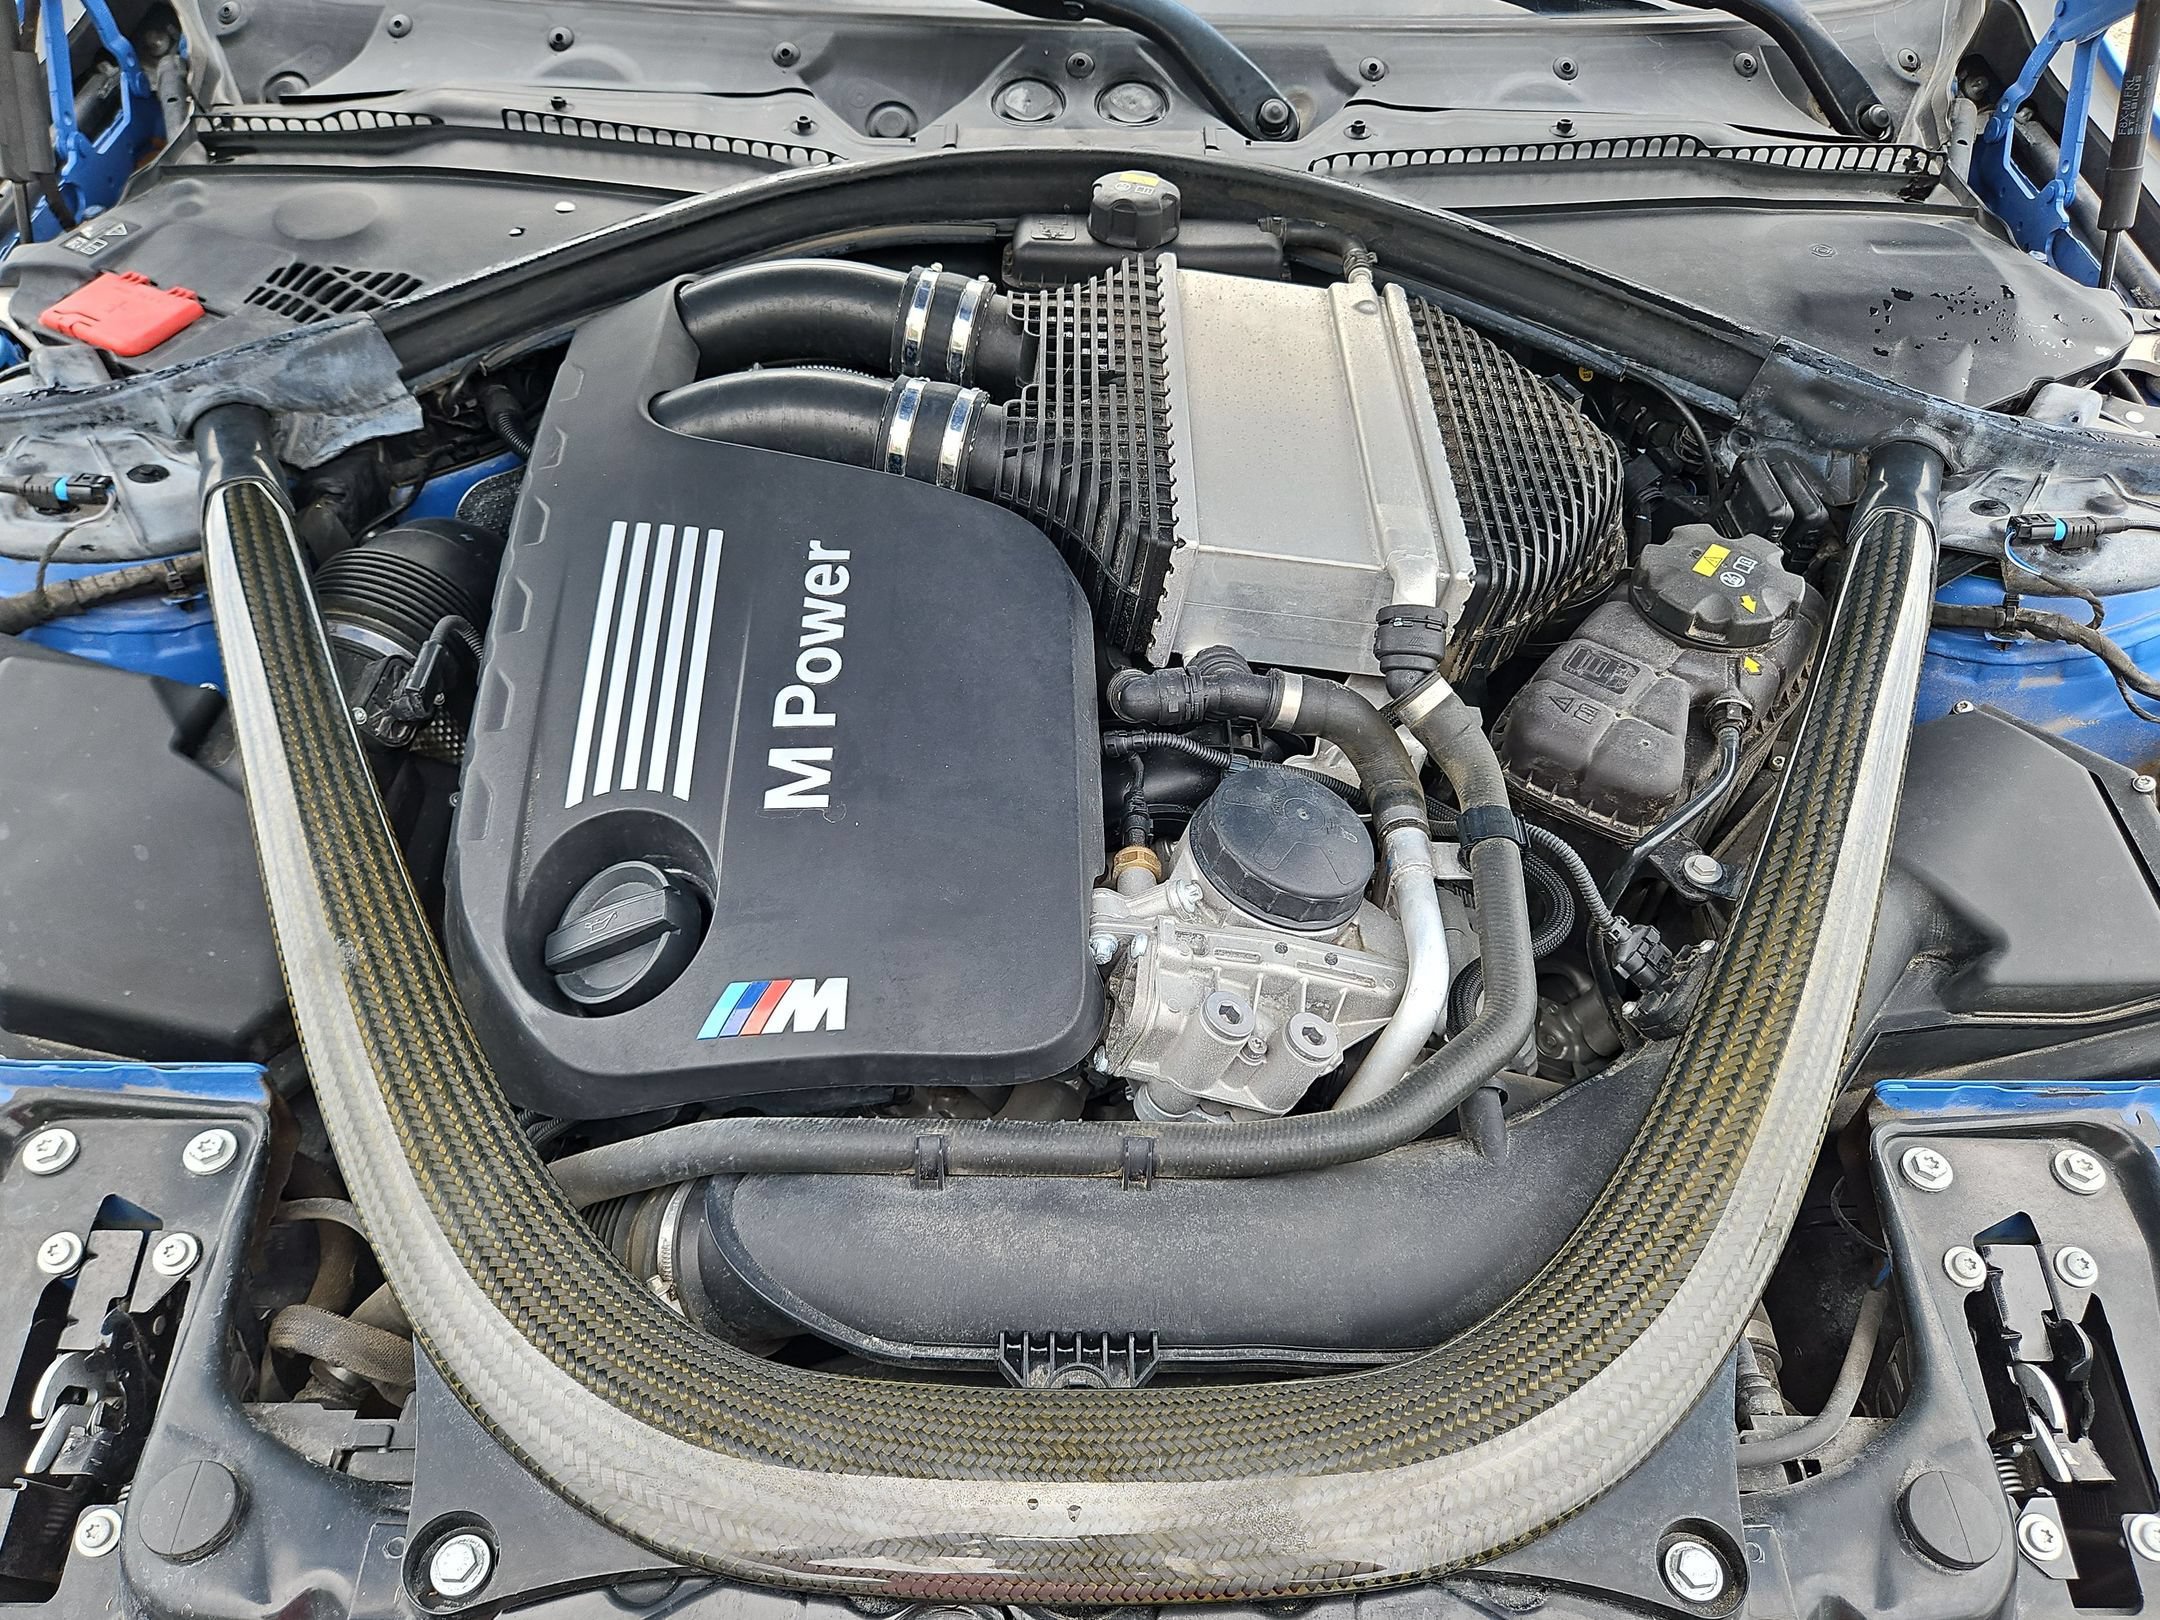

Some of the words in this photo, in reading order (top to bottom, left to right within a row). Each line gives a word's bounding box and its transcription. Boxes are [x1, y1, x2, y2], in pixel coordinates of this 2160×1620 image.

[2127, 75, 2142, 135] STABILUS
[772, 539, 851, 728] Power
[763, 747, 834, 809] M
[761, 977, 850, 1036] M
